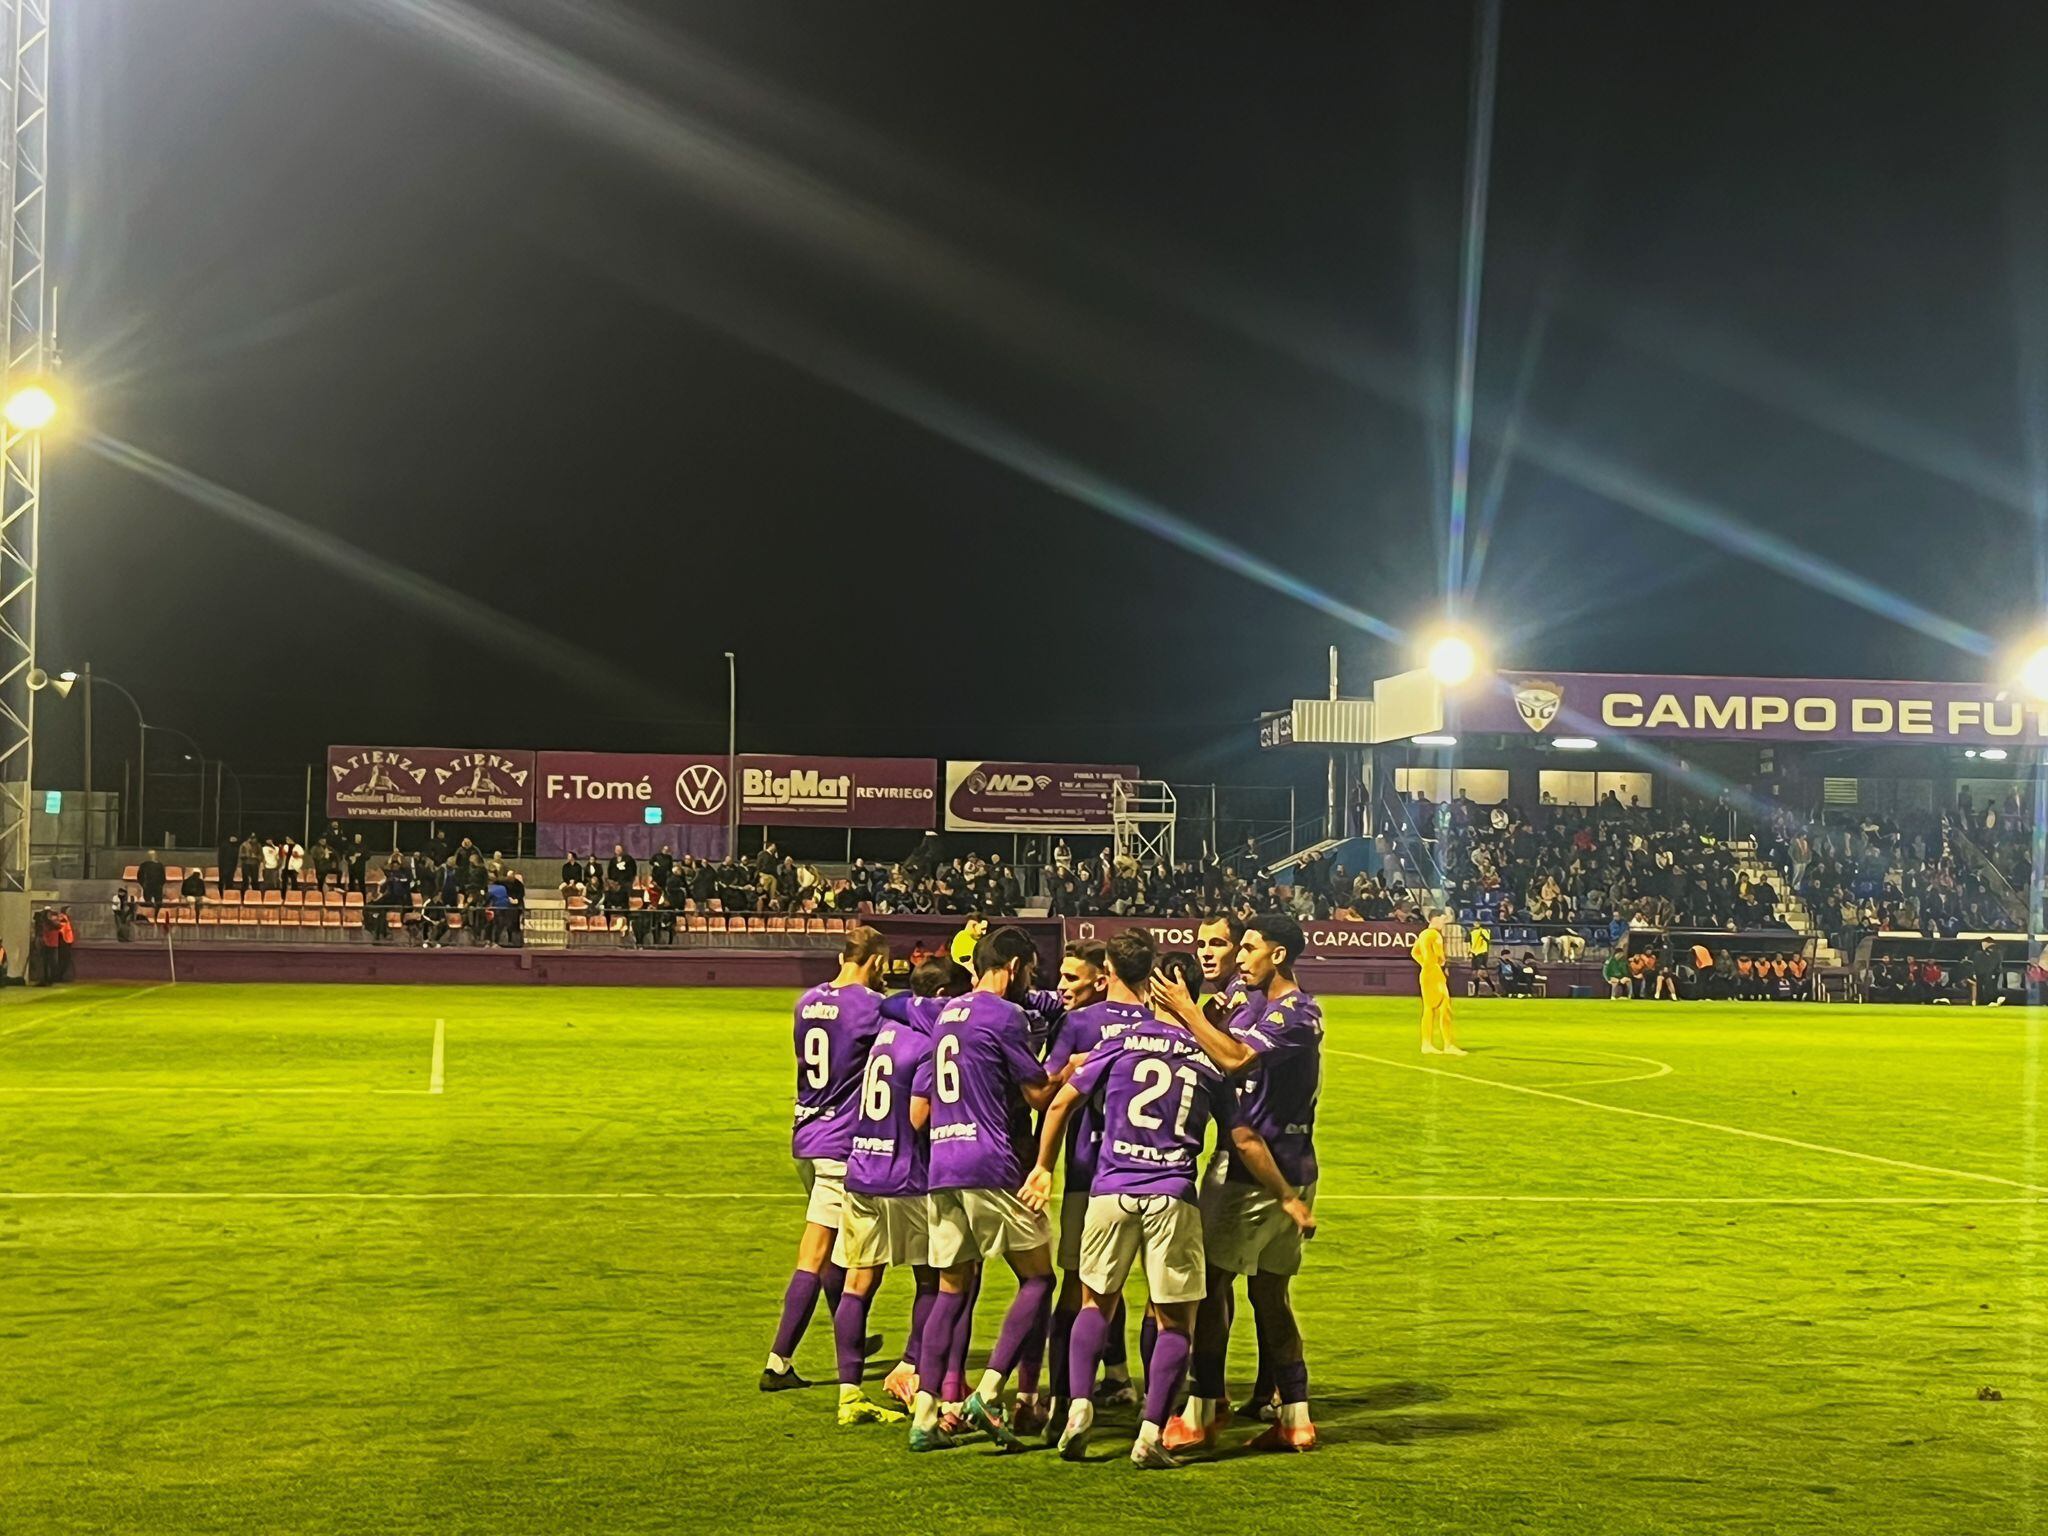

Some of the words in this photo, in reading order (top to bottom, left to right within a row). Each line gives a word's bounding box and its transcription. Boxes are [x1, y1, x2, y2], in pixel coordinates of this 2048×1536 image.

[1602, 693, 1836, 731] CAMPO
[1852, 699, 1934, 733] DE
[332, 751, 427, 785] ATIENZA
[434, 753, 528, 788] ATIENZA
[547, 775, 652, 800] F.Tomé
[743, 769, 851, 804] BigMat
[856, 787, 934, 800] REVIRIEGO
[804, 1027, 830, 1090] 9
[1123, 1036, 1170, 1053] MANU
[936, 1034, 960, 1104] 6
[1127, 1058, 1198, 1137] 21
